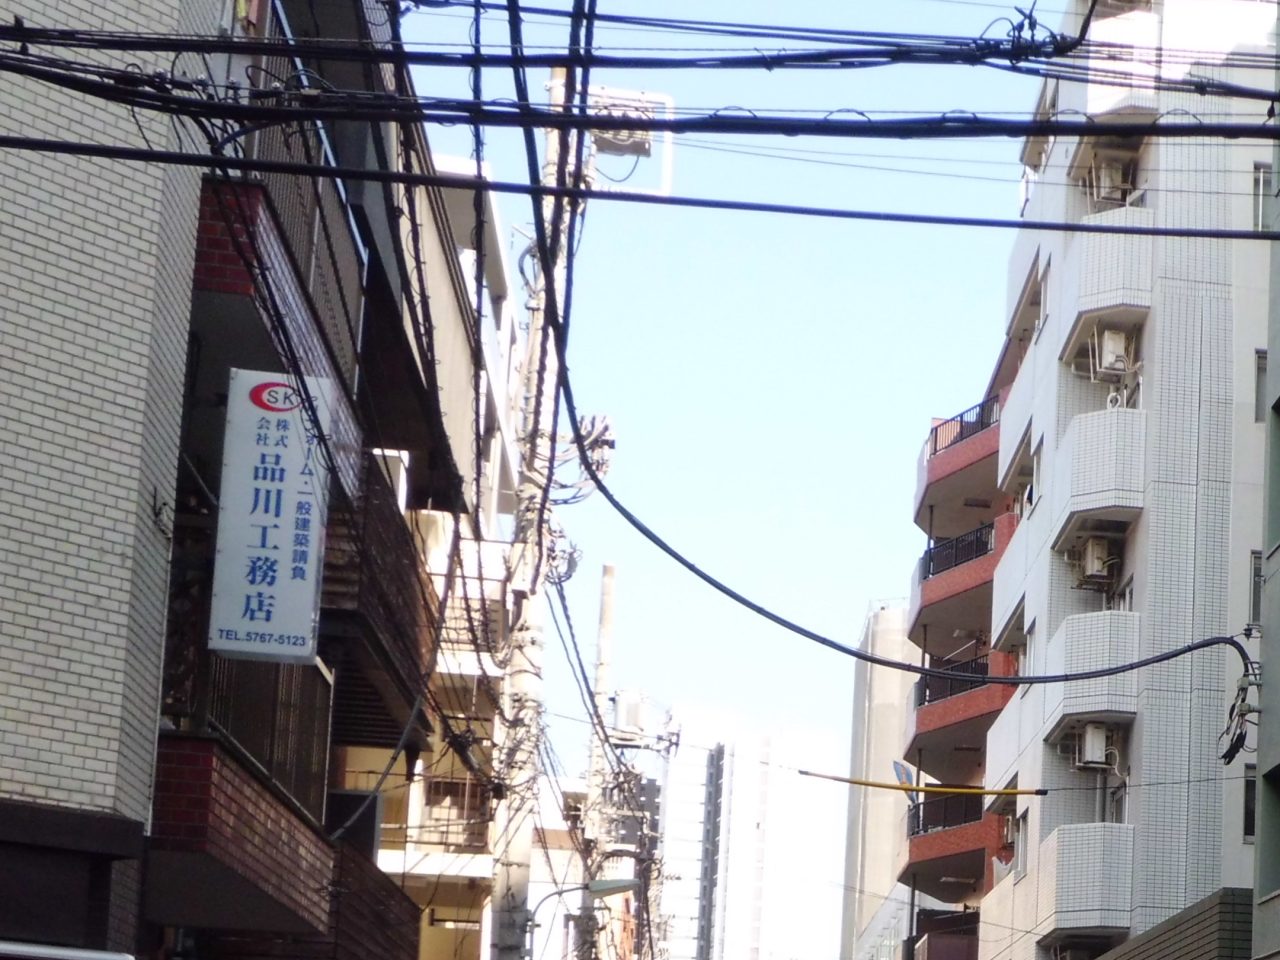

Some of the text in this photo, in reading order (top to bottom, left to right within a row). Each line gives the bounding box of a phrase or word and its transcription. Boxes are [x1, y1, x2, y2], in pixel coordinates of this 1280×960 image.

[241, 453, 286, 622] 品川工務店
